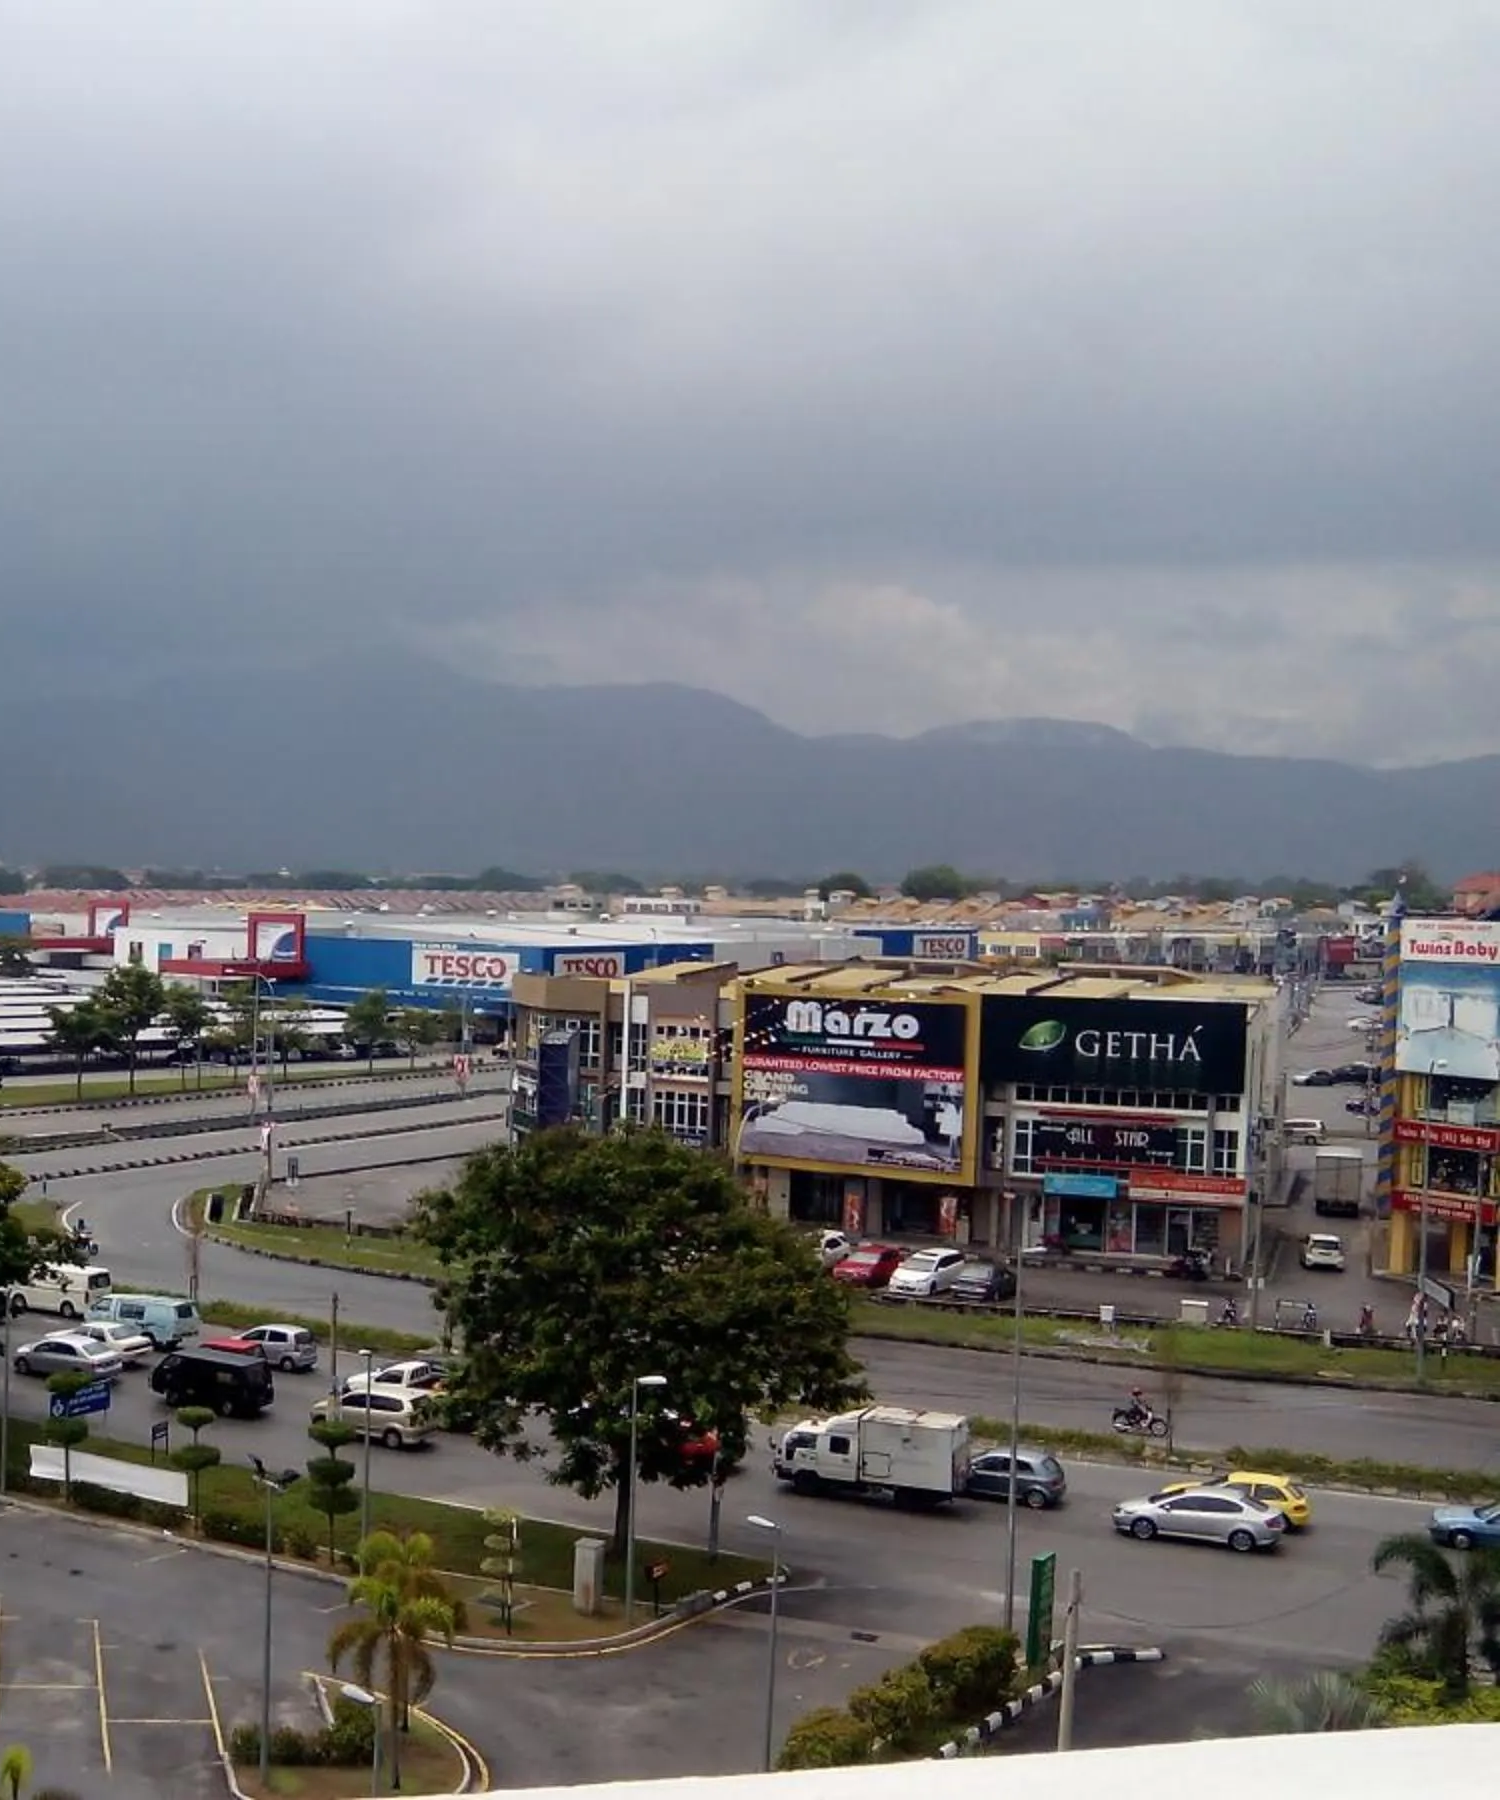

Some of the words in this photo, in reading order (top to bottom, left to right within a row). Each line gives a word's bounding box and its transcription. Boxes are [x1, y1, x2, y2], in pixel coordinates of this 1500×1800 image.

[920, 938, 965, 953] TESCO
[1409, 939, 1452, 956] Twins
[1454, 940, 1498, 960] Baby
[424, 954, 507, 979] TESCO
[563, 958, 618, 978] TESCO
[786, 1000, 921, 1040] Marzo
[802, 1046, 855, 1057] FURNITURE
[859, 1049, 901, 1059] GALLERY
[1075, 1025, 1203, 1062] GETHÁ
[743, 1069, 795, 1083] GRAND
[805, 1061, 847, 1073] LOWEST
[848, 1063, 879, 1075] PRICE
[880, 1067, 912, 1078] FROM
[914, 1068, 964, 1081] FACTORY
[1066, 1127, 1095, 1146] ALL
[1115, 1129, 1150, 1148] STAR
